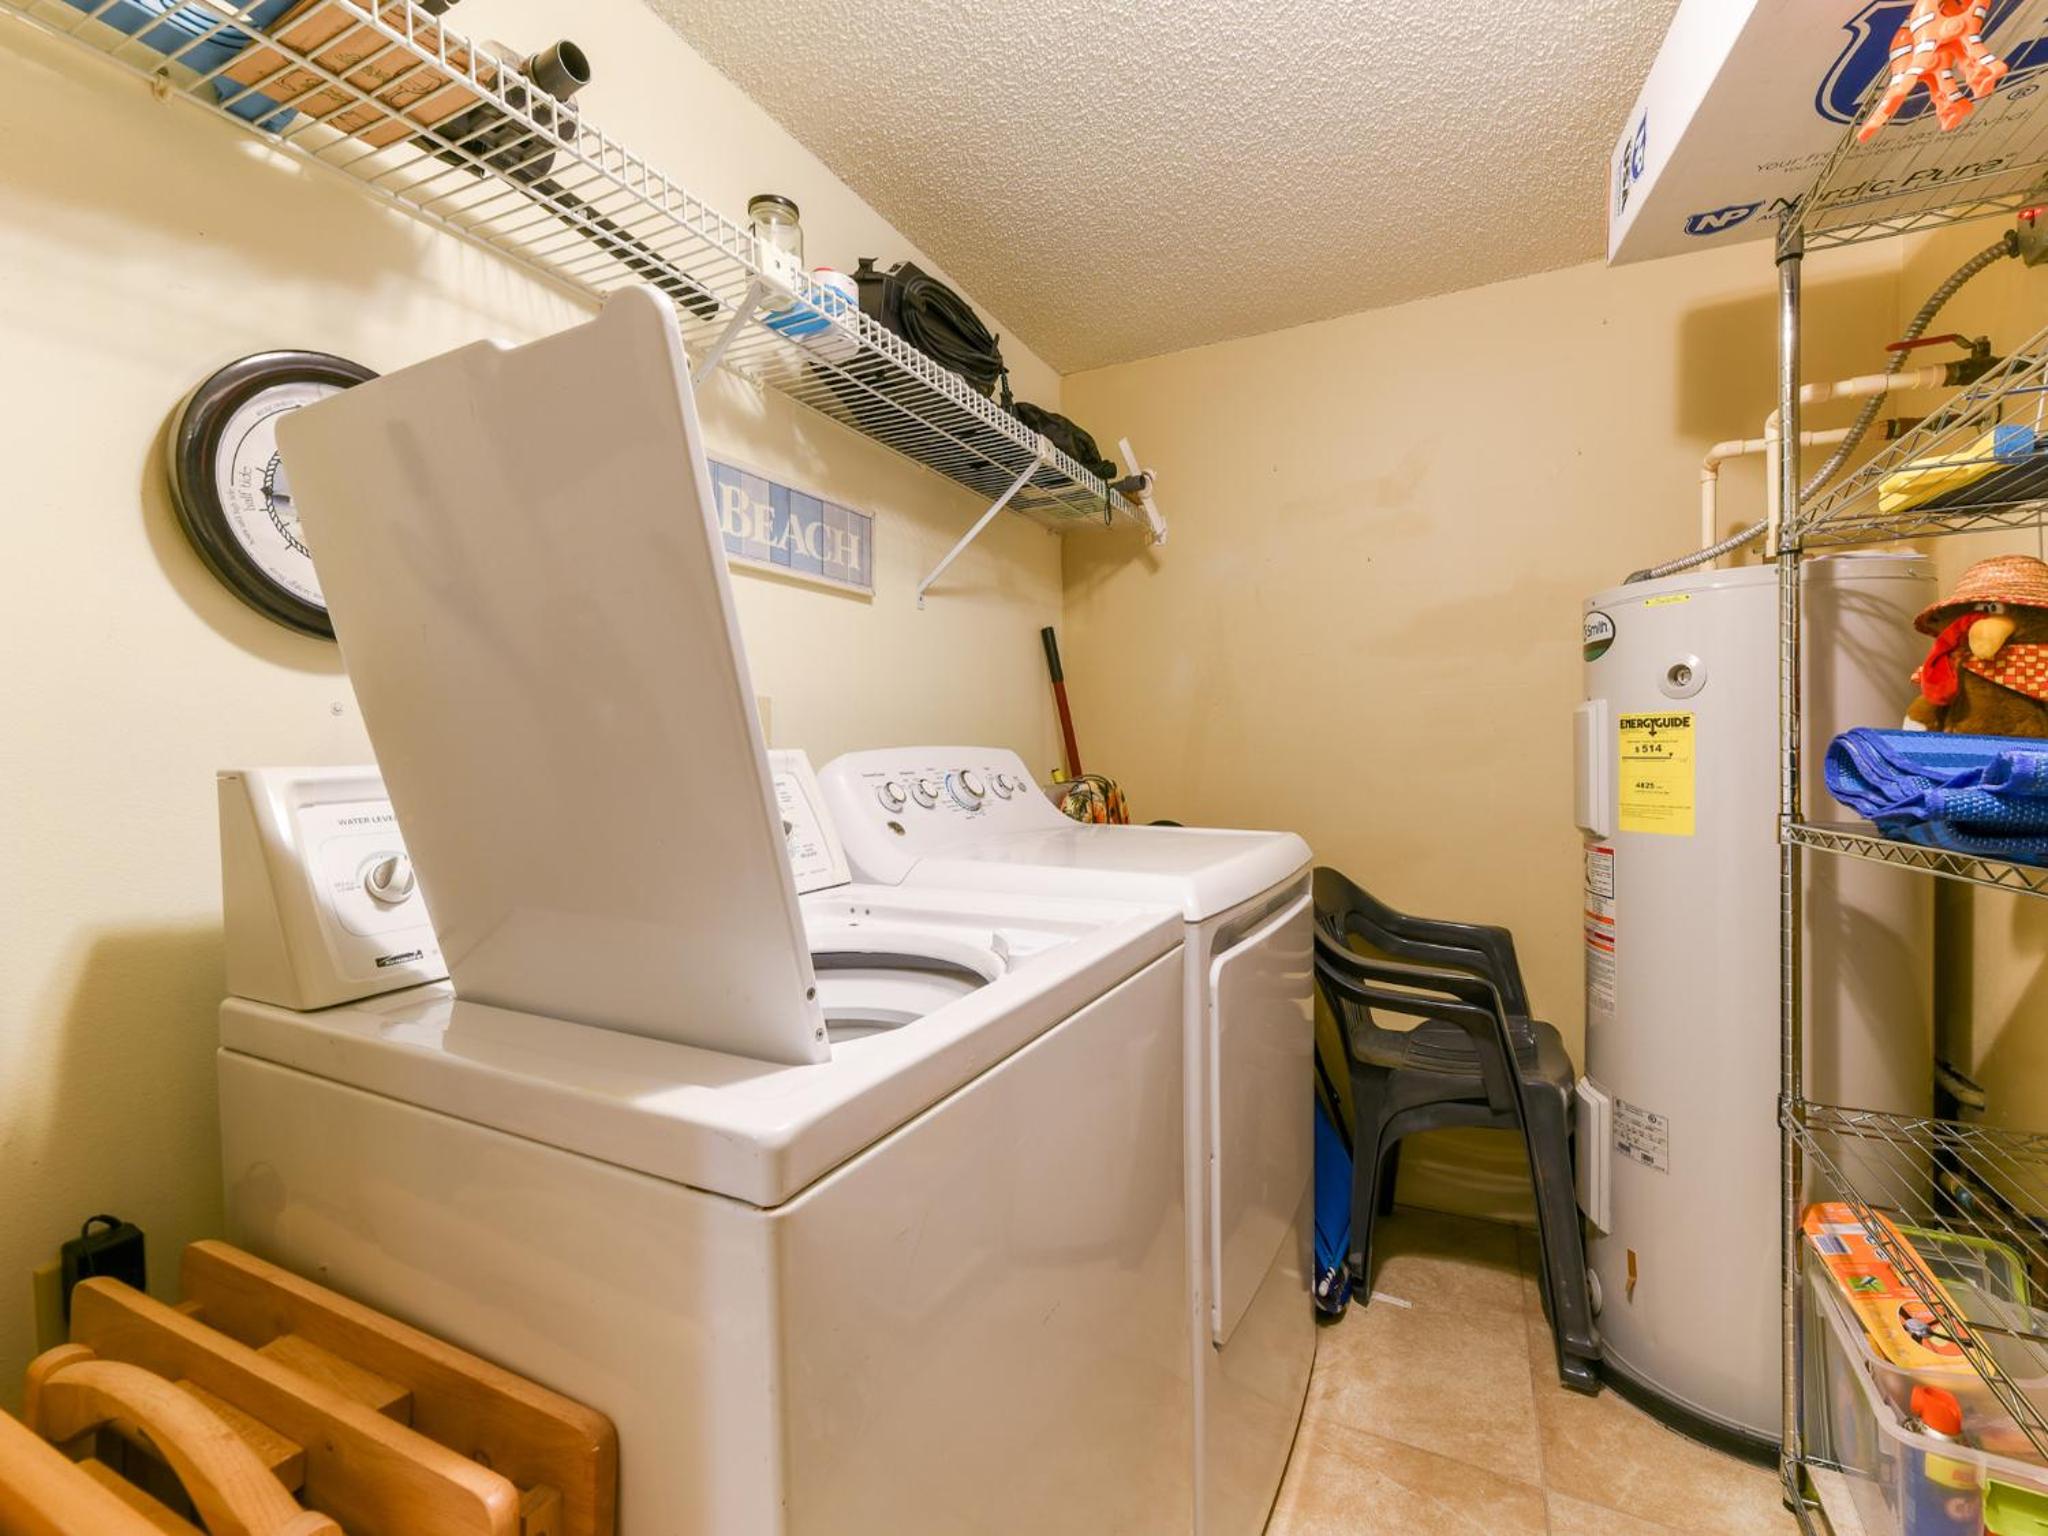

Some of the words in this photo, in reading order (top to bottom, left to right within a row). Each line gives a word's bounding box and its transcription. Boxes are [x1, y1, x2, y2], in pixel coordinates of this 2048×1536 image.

[1768, 180, 1895, 211] Nrdic
[1694, 208, 1750, 232] NP
[718, 481, 862, 572] BEACH
[1619, 716, 1691, 730] ENERGYGUIDE
[371, 814, 395, 824] LEVE
